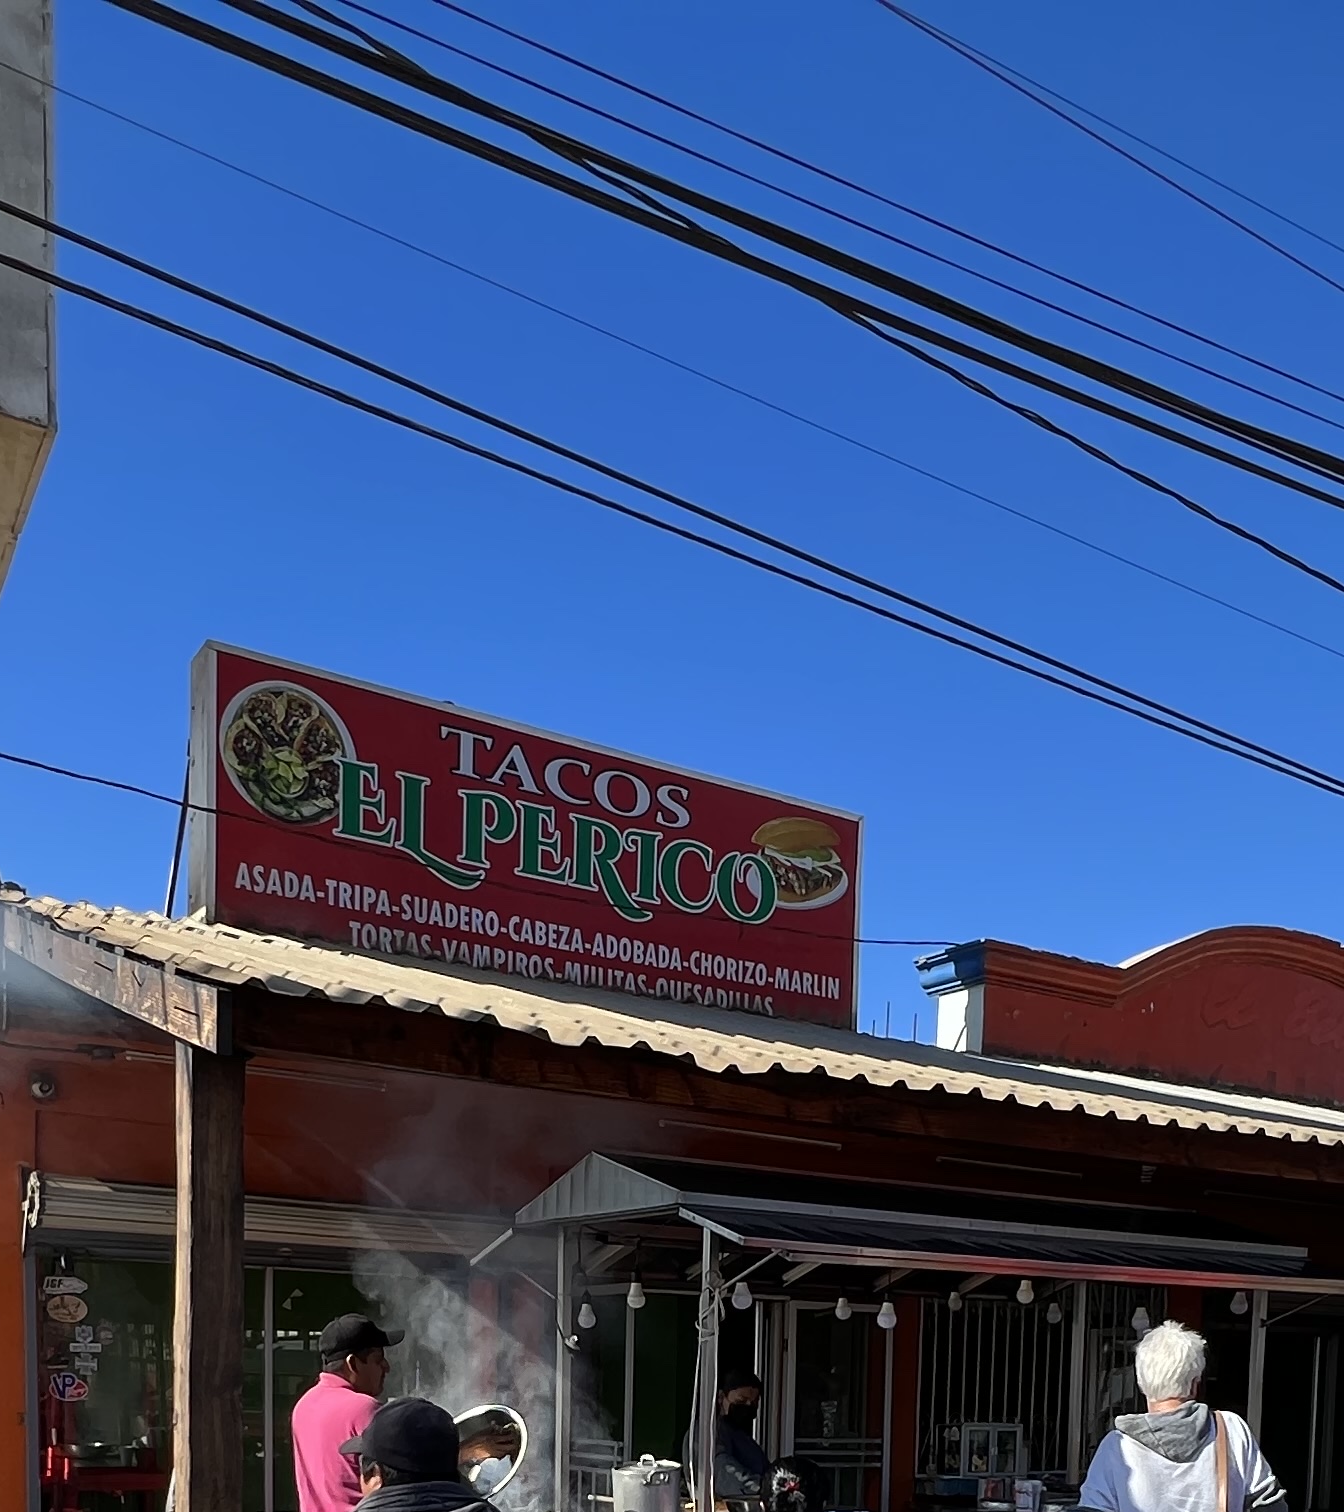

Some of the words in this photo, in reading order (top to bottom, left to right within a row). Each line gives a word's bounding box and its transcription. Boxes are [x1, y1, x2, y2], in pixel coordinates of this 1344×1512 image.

[441, 726, 691, 829] TACOS
[333, 758, 485, 890] EL
[458, 788, 778, 924] PERICO
[51, 1373, 76, 1399] VP
